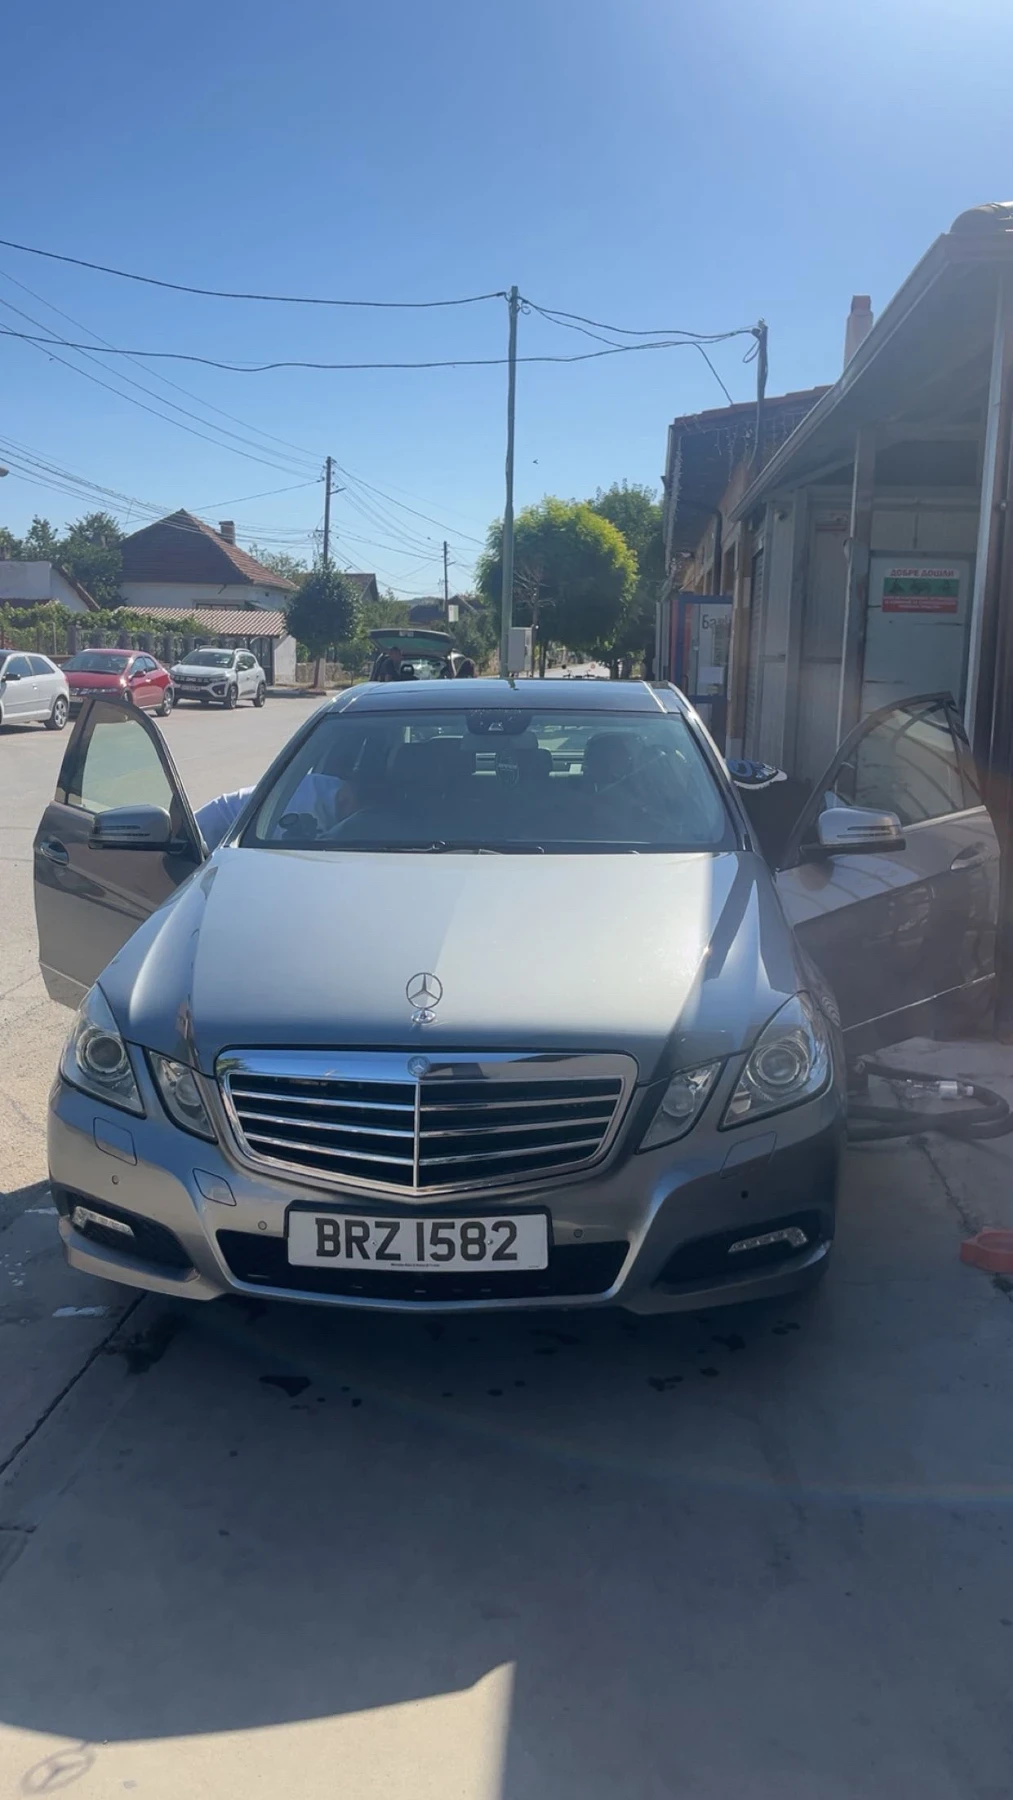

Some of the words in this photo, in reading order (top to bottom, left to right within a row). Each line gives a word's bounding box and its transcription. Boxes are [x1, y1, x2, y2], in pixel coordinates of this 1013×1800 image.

[890, 569, 919, 577] ДОБРЕ
[920, 569, 955, 577] ДОШЛИ
[315, 1218, 401, 1260] BRZ
[416, 1220, 518, 1262] 1582
